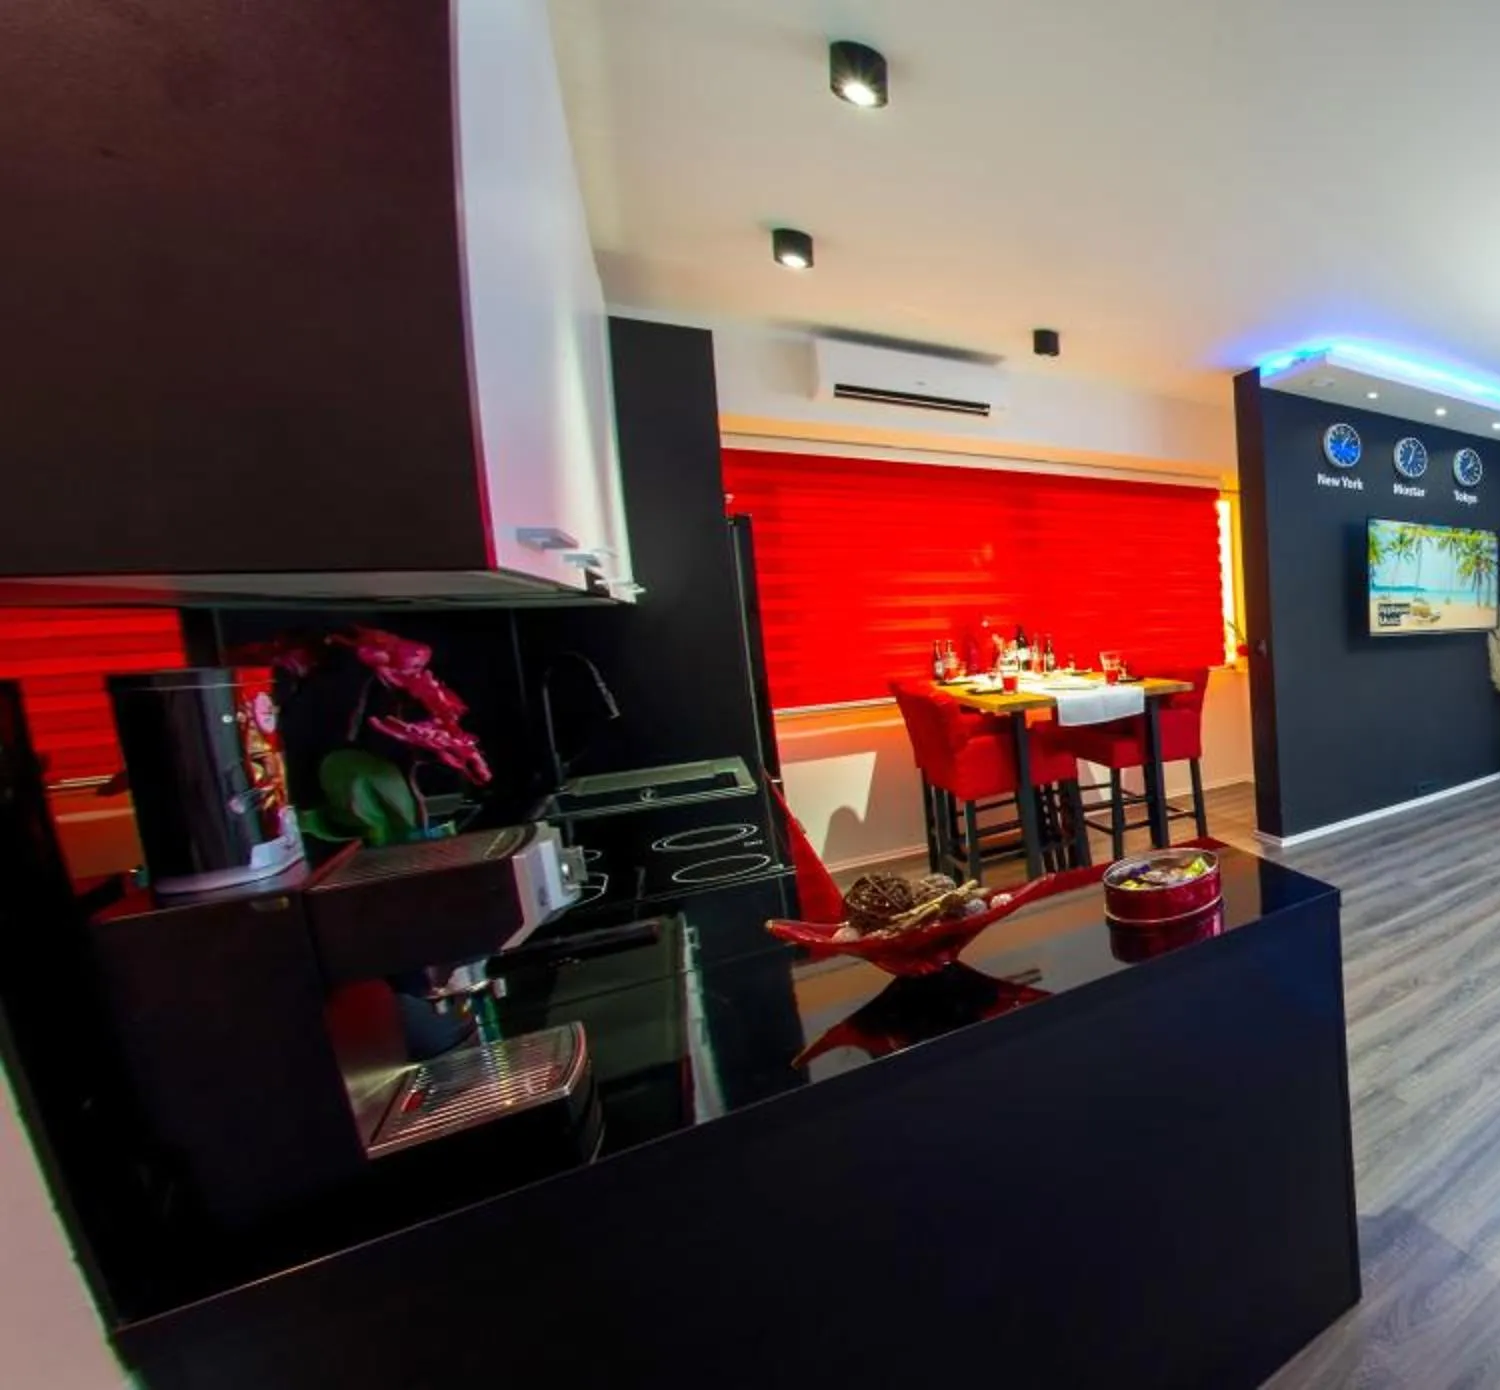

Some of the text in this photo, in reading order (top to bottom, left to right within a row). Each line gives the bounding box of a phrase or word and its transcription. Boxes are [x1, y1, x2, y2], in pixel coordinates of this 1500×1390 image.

[1317, 473, 1364, 491] New York
[1453, 490, 1478, 505] Tokyo
